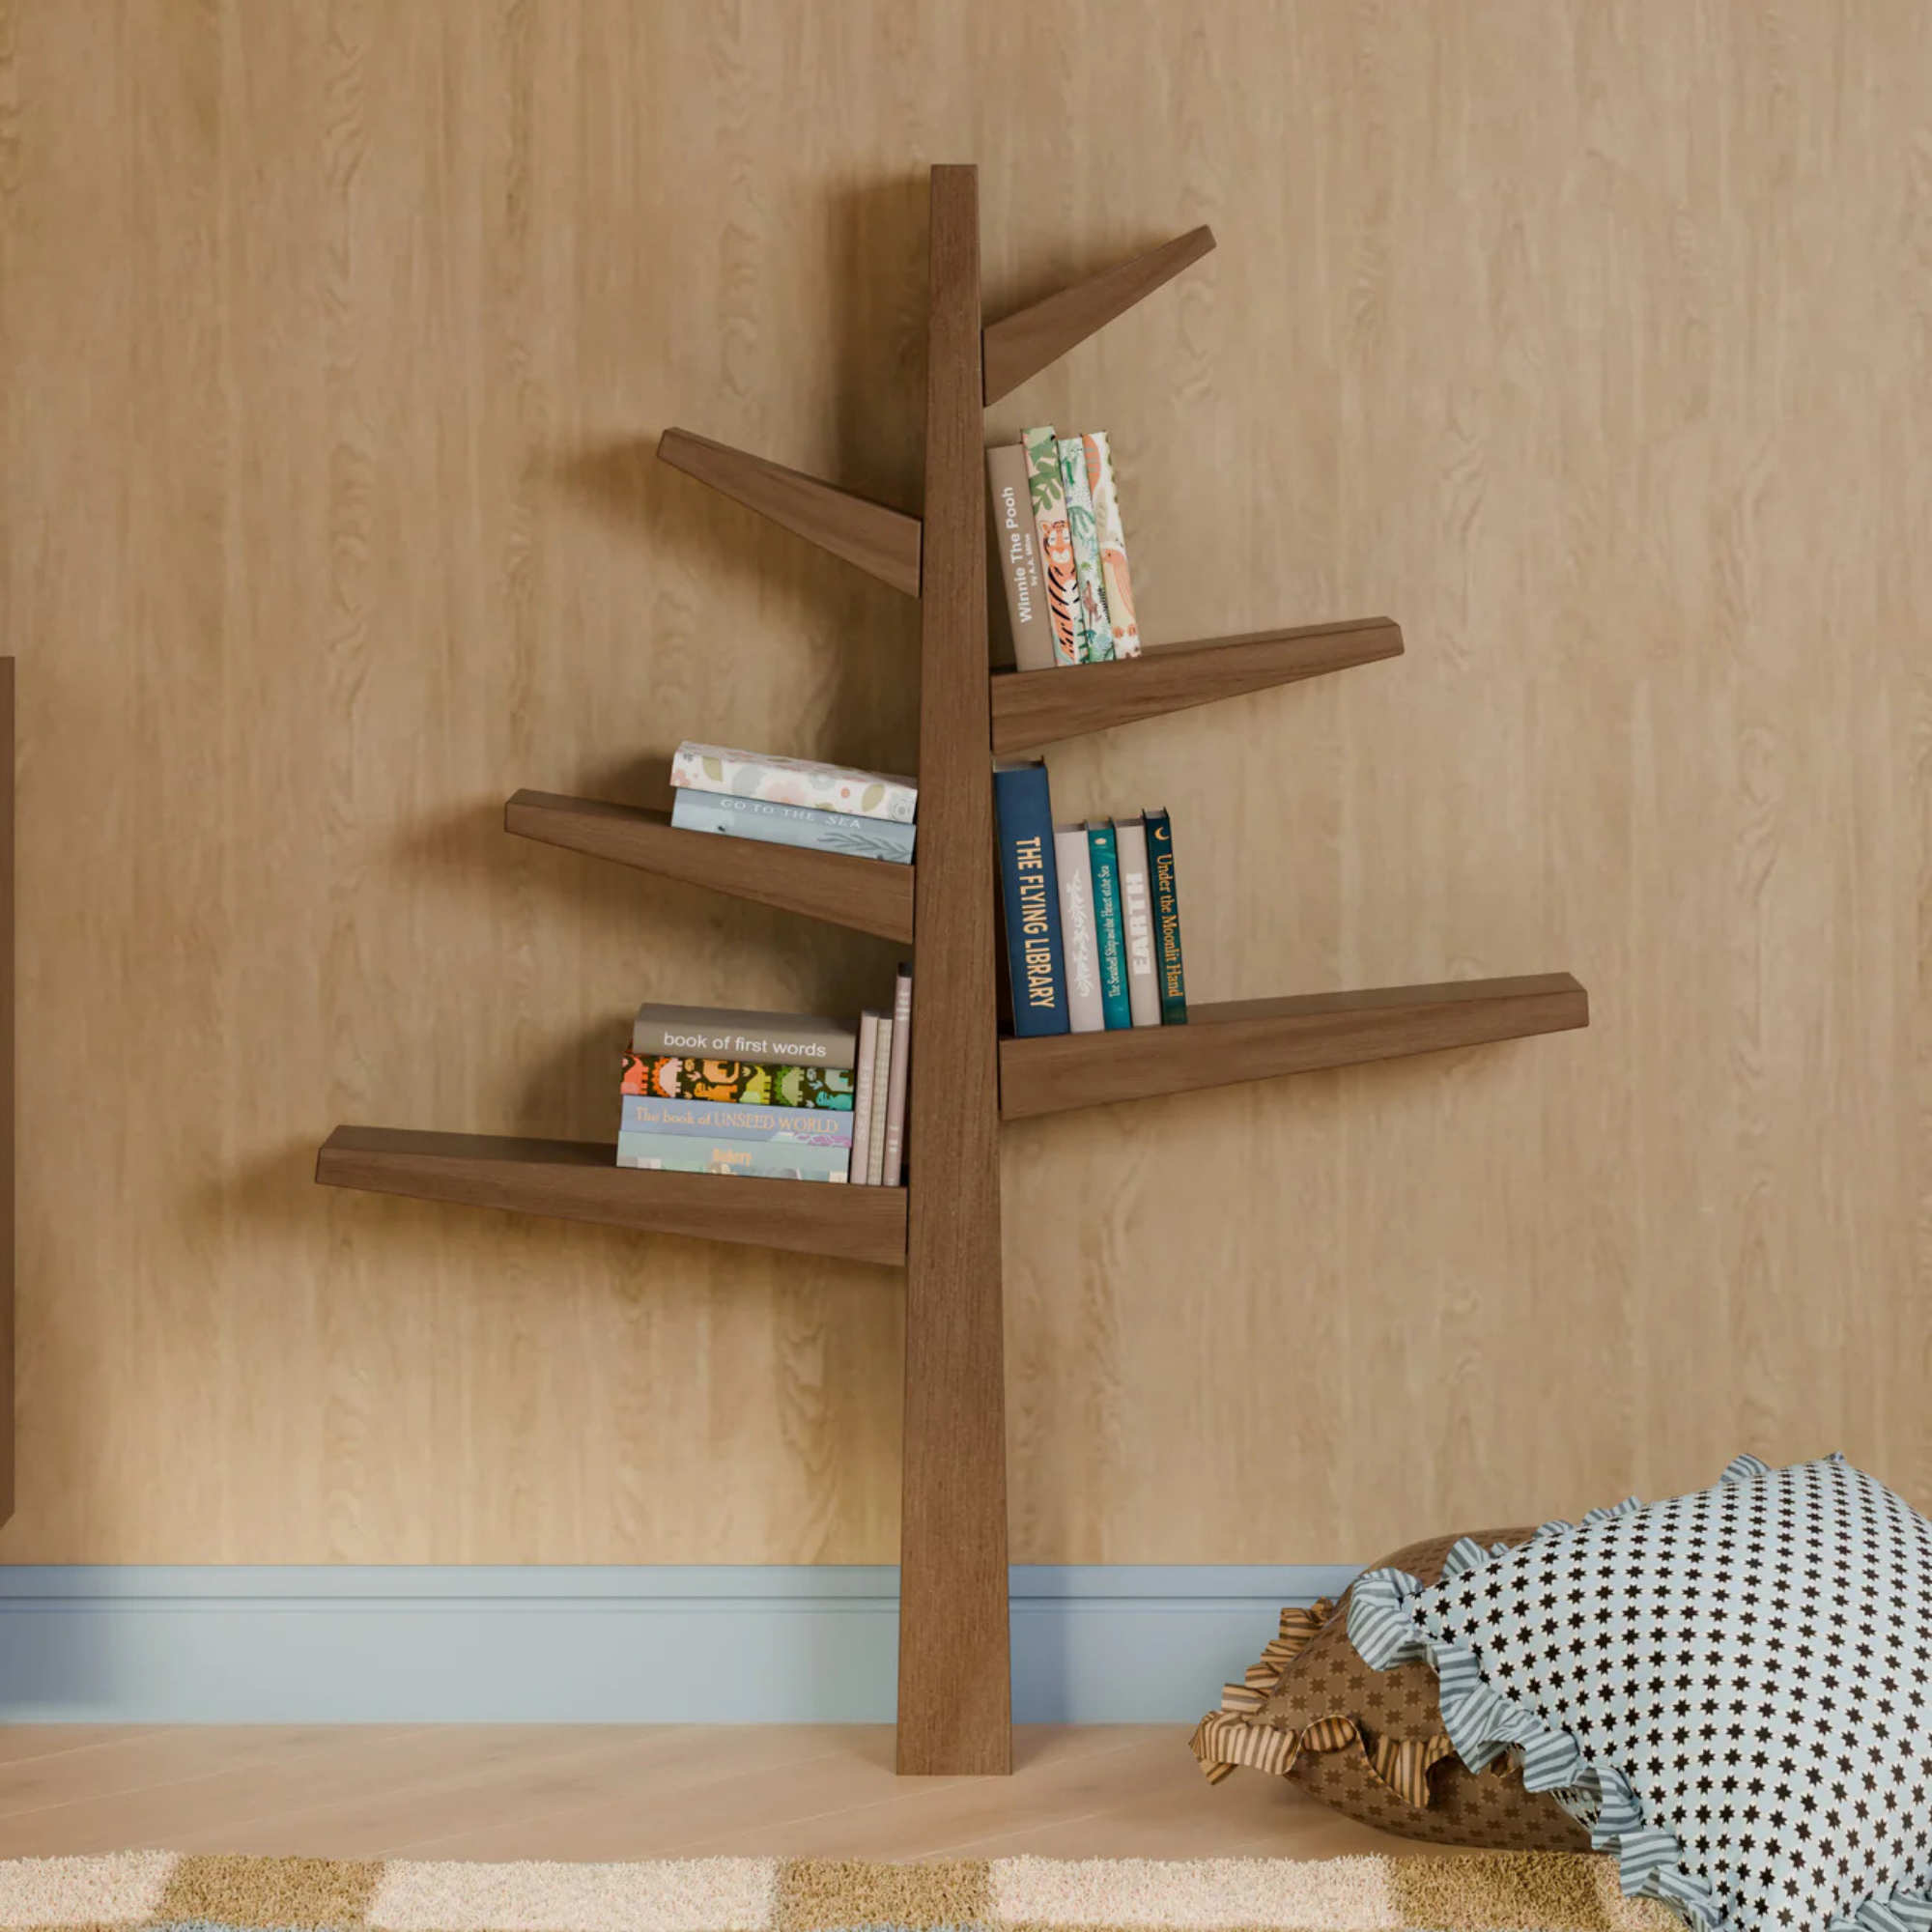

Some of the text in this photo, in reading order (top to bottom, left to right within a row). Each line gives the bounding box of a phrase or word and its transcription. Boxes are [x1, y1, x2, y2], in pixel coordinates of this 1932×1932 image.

[1002, 487, 1033, 624] Winnie The Pooh
[720, 799, 862, 829] GO TO THE SEA
[1016, 837, 1055, 1009] THE FLYING LIBRARY
[1125, 873, 1151, 975] EARTH
[1157, 854, 1183, 997] Under the Moonlit Hand
[664, 1032, 827, 1058] book of first words
[636, 1107, 660, 1122] The
[663, 1109, 695, 1124] book
[698, 1112, 710, 1125] of
[779, 1116, 838, 1133] WORLD
